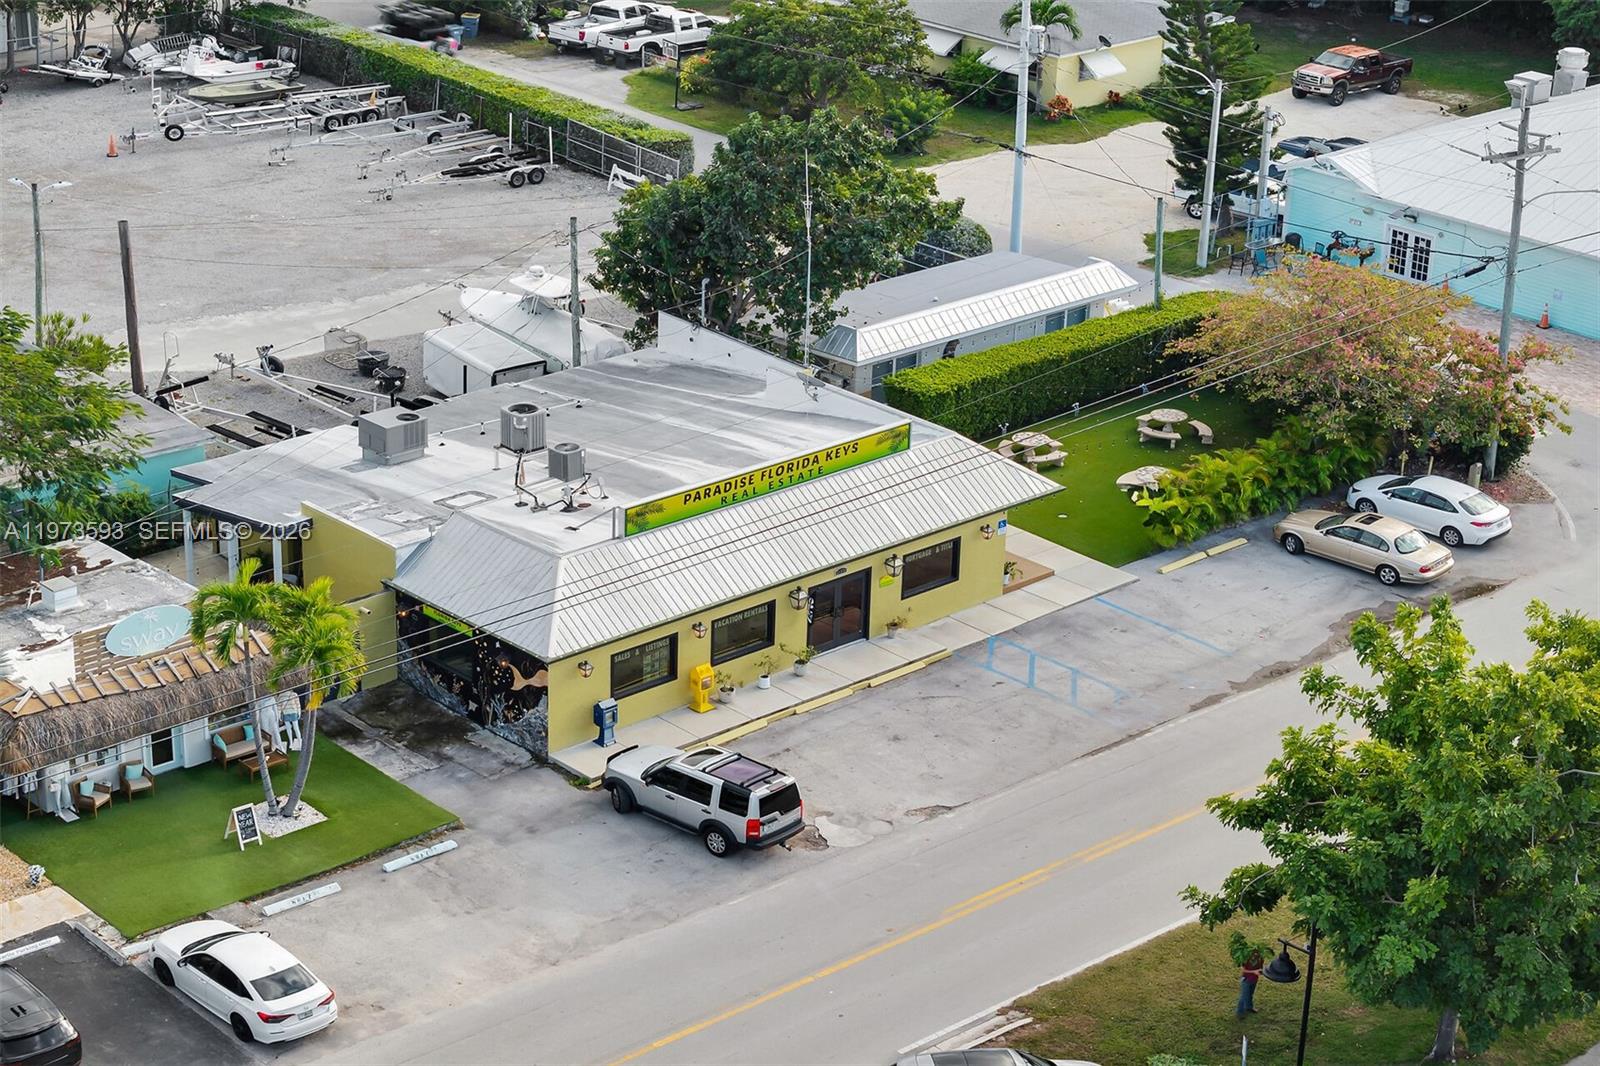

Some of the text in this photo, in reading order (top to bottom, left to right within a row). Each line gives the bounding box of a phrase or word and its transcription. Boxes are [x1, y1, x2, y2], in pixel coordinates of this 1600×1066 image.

[683, 442, 859, 505] PARADISE FLORIDA KEYS
[720, 465, 825, 505] REAL ESTATE
[714, 612, 743, 629] VACATION
[614, 651, 631, 663] SALES
[645, 639, 670, 652] LISTINGS
[237, 811, 253, 821] NEW
